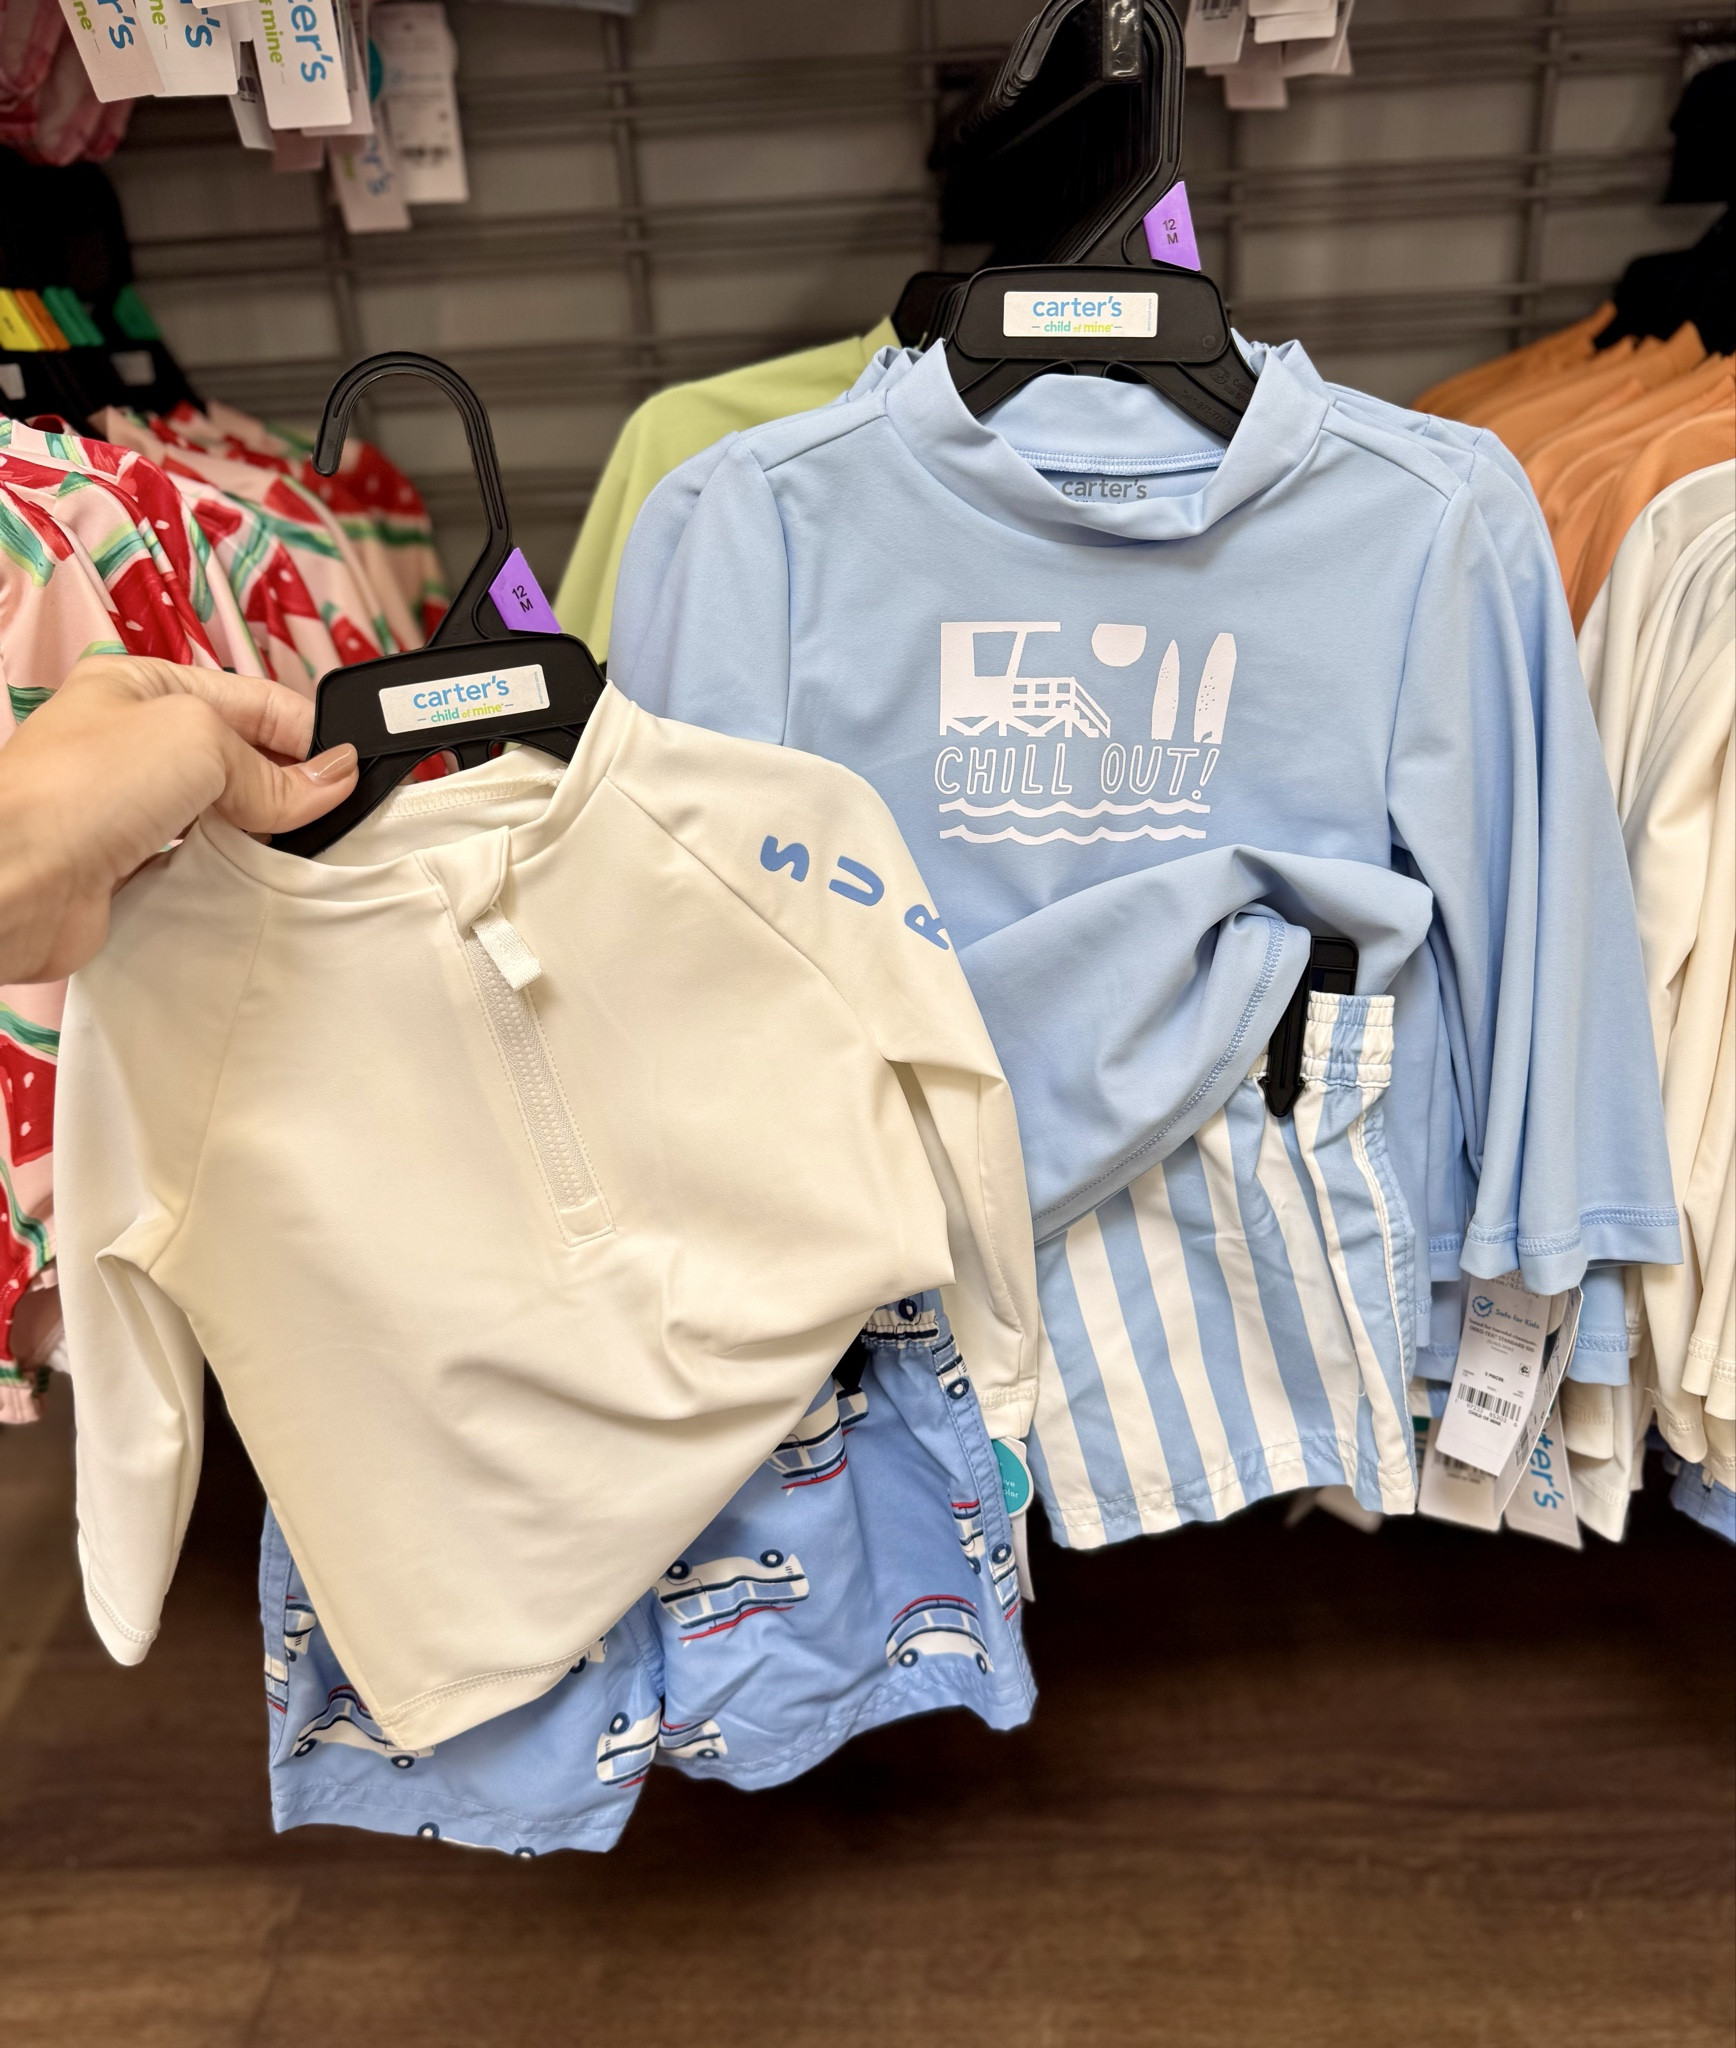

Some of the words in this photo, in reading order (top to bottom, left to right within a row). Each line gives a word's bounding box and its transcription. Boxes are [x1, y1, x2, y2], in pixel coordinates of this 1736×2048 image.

[261, 10, 284, 63] mine
[288, 0, 334, 83] er's
[1162, 219, 1177, 231] 12
[1166, 232, 1179, 245] M
[1032, 295, 1123, 318] carter's
[1043, 320, 1072, 333] child
[1073, 324, 1083, 333] of
[1083, 321, 1112, 333] mine
[1061, 479, 1147, 499] carter's
[512, 585, 528, 600] 12
[520, 598, 534, 613] M
[413, 675, 510, 710] carter's
[430, 708, 460, 723] child
[461, 709, 471, 719] of
[472, 703, 503, 717] mine
[934, 744, 1073, 795] CHILL
[1100, 743, 1220, 800] OUT!
[1529, 1429, 1564, 1509] ter's
